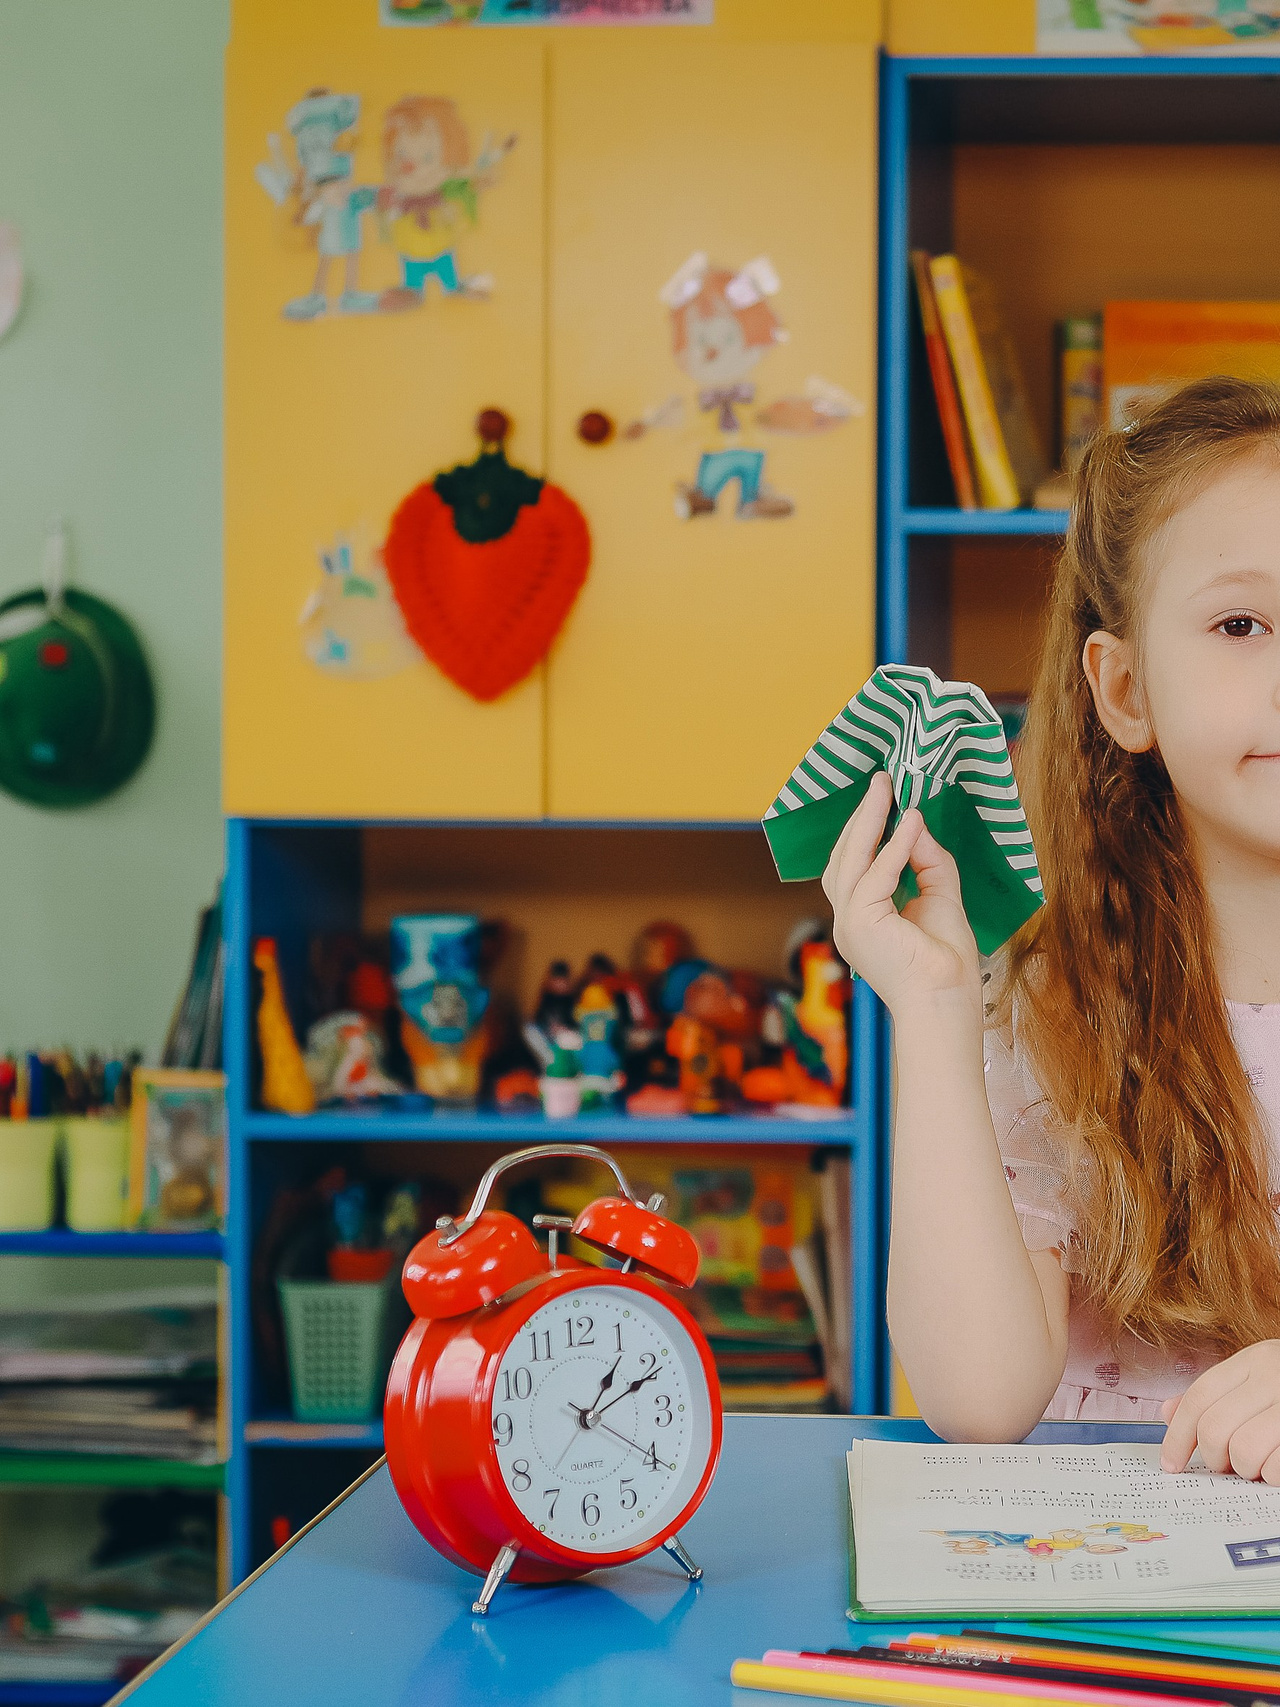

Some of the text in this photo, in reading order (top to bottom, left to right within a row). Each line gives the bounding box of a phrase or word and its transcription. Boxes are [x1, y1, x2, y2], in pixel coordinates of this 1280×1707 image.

[528, 1329, 554, 1363] 11
[564, 1315, 595, 1348] 12
[613, 1322, 625, 1353] 1
[639, 1352, 658, 1381] 2
[501, 1366, 532, 1402] 10
[653, 1394, 673, 1427] 3
[493, 1413, 513, 1447] 9
[570, 1460, 604, 1472] QUARTZ
[642, 1441, 661, 1473] 4
[511, 1457, 532, 1492] 8
[542, 1488, 561, 1521] 7
[580, 1492, 601, 1527] 6
[619, 1477, 638, 1510] 5
